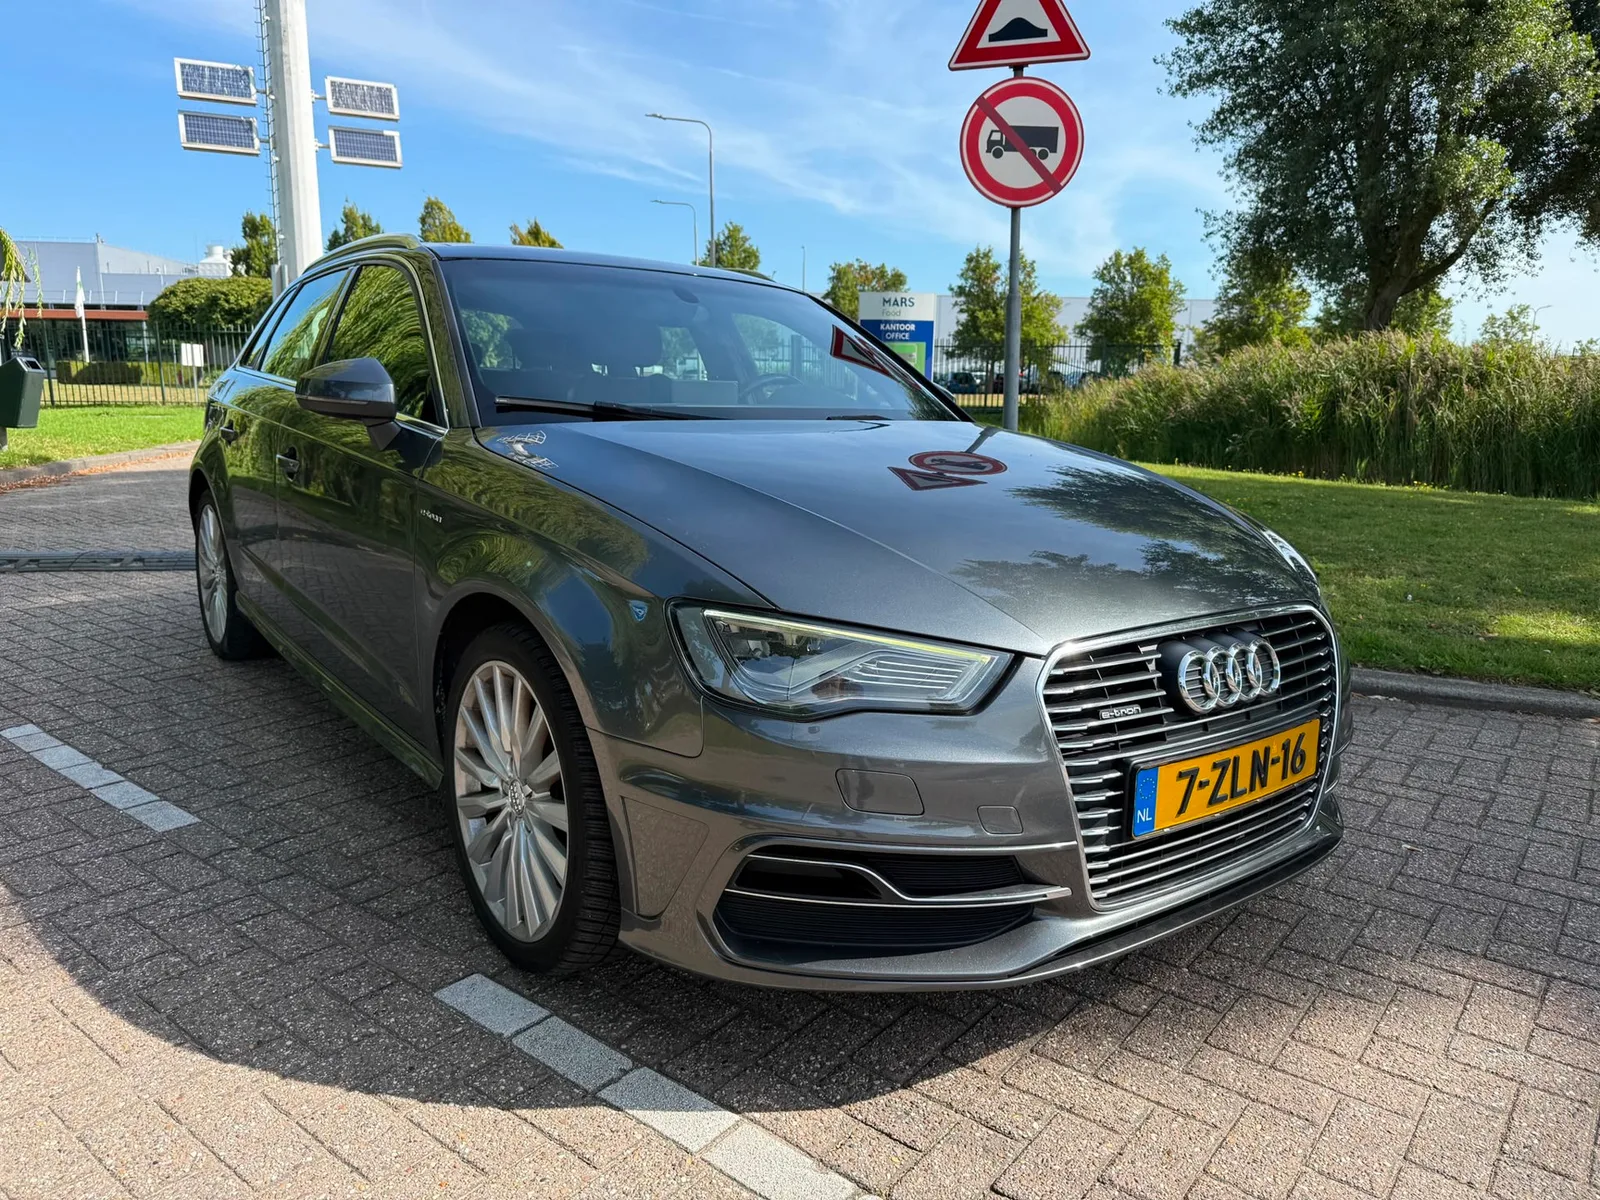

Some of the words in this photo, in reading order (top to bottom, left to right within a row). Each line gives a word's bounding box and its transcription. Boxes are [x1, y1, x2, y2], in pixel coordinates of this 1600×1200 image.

[882, 297, 915, 307] MARS
[885, 332, 910, 340] OFFICE
[1101, 706, 1142, 719] e-tron
[1176, 732, 1306, 818] 7-ZLN-16
[1136, 808, 1152, 824] NL
